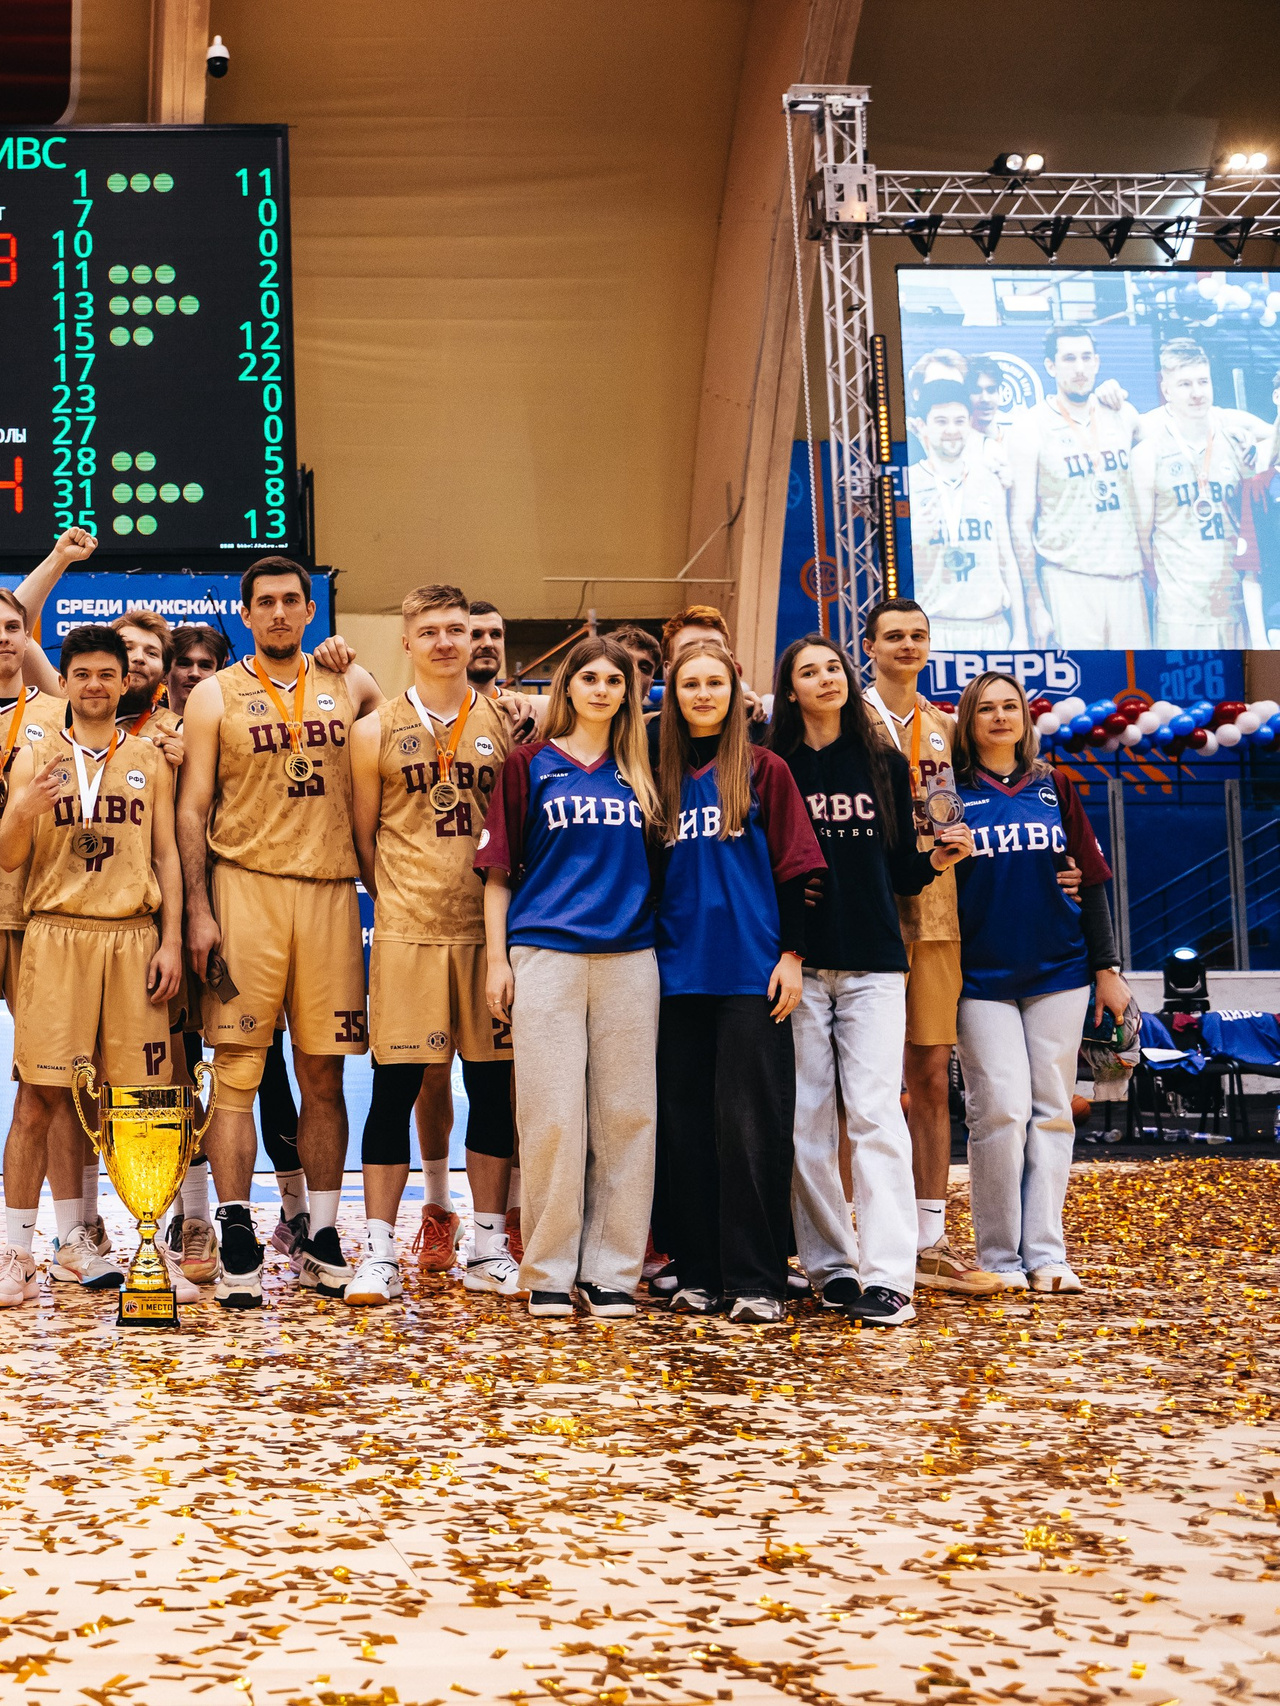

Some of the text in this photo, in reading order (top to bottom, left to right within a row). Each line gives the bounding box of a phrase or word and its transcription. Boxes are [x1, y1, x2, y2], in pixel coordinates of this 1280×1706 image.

[75, 169, 87, 197] 1
[236, 168, 271, 196] 11
[73, 200, 93, 227] 7
[258, 199, 277, 226] 0
[52, 230, 92, 258] 10
[259, 229, 278, 257] 0
[52, 261, 88, 289] 11
[259, 260, 279, 288] 2
[53, 291, 94, 320] 13
[261, 290, 279, 319] 0
[54, 322, 94, 351] 15
[240, 321, 280, 350] 12
[54, 353, 95, 382] 17
[239, 352, 281, 381] 22
[52, 384, 95, 413] 23
[263, 383, 282, 412] 0
[53, 416, 96, 445] 27
[264, 415, 283, 443] 0
[53, 447, 96, 476] 28
[265, 446, 284, 475] 5
[53, 479, 91, 508] 31
[265, 478, 284, 506] 8
[244, 509, 286, 538] 13
[57, 599, 123, 617] СРЕДИ
[1160, 659, 1226, 700] 2026
[435, 801, 473, 838] 28
[971, 822, 1066, 858] ЦИВС
[334, 1010, 365, 1043] 35
[146, 1303, 173, 1311] МЕСТО
